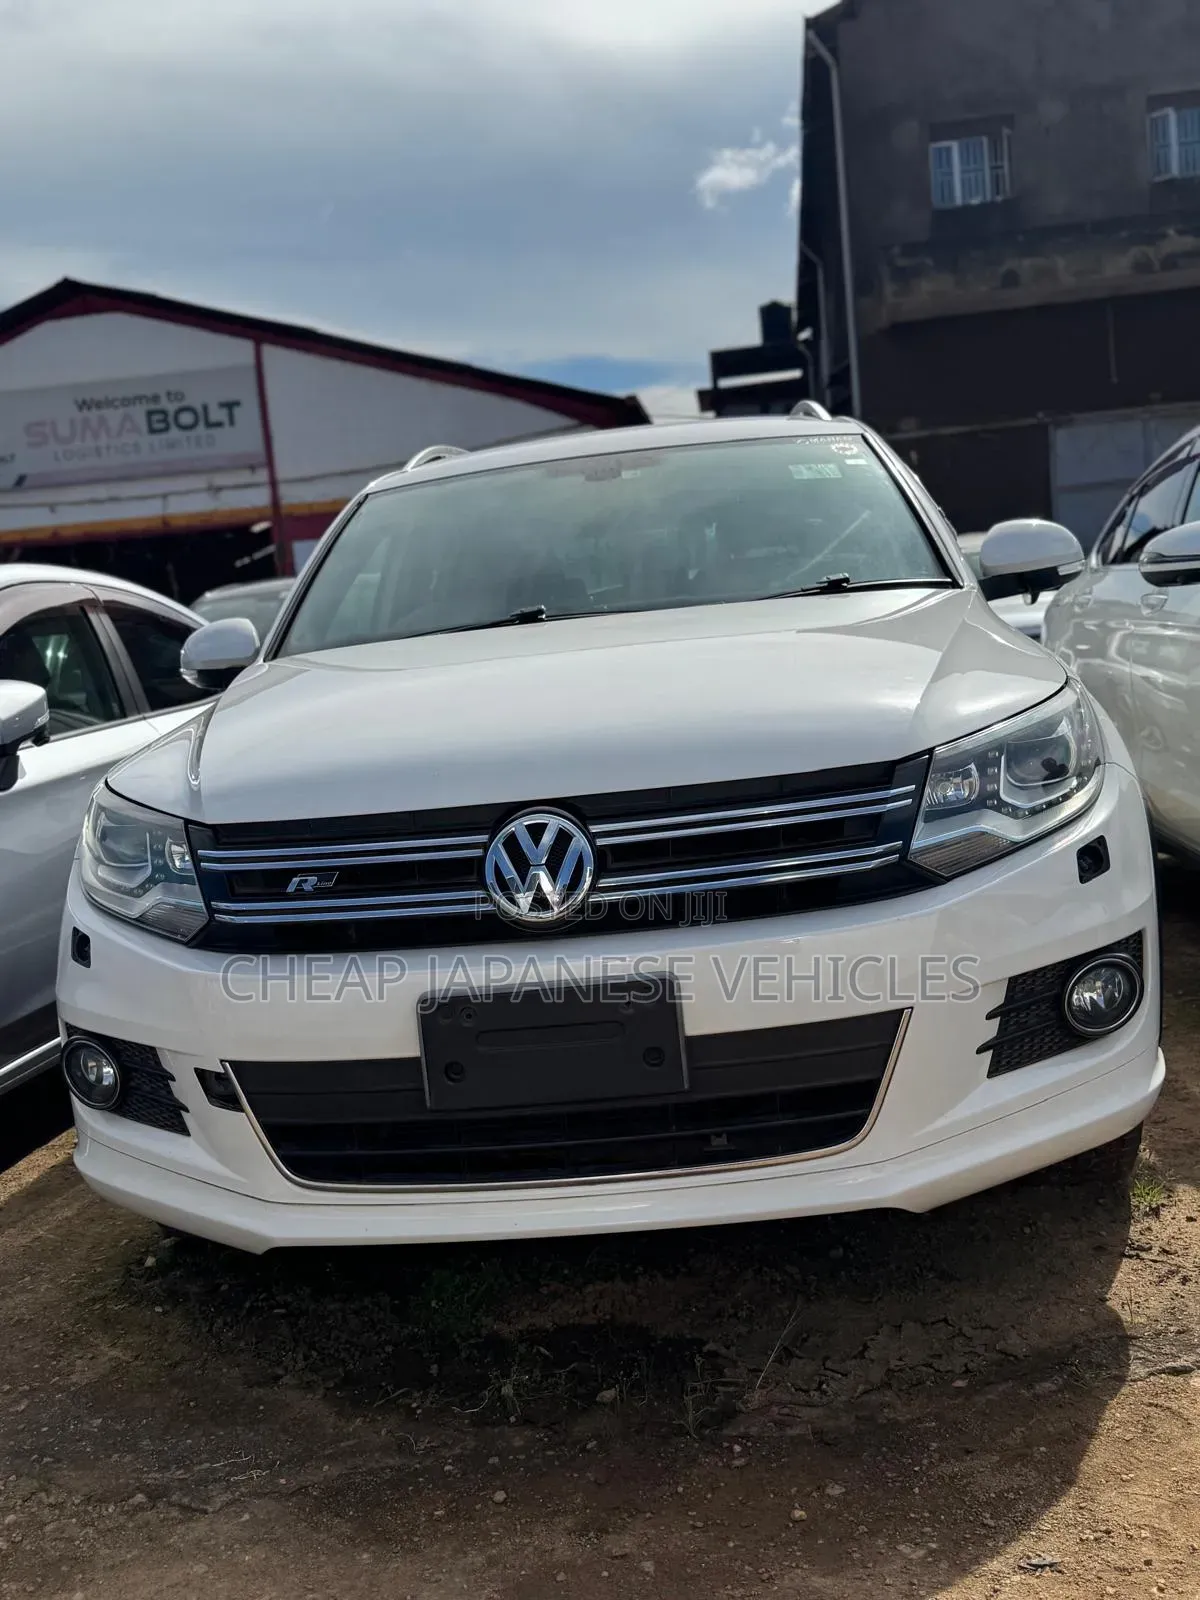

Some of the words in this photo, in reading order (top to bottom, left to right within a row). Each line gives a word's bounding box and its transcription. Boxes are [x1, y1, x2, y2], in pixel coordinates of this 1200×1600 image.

[73, 391, 162, 413] Welcome
[165, 389, 186, 404] to
[148, 433, 217, 455] LIMITED
